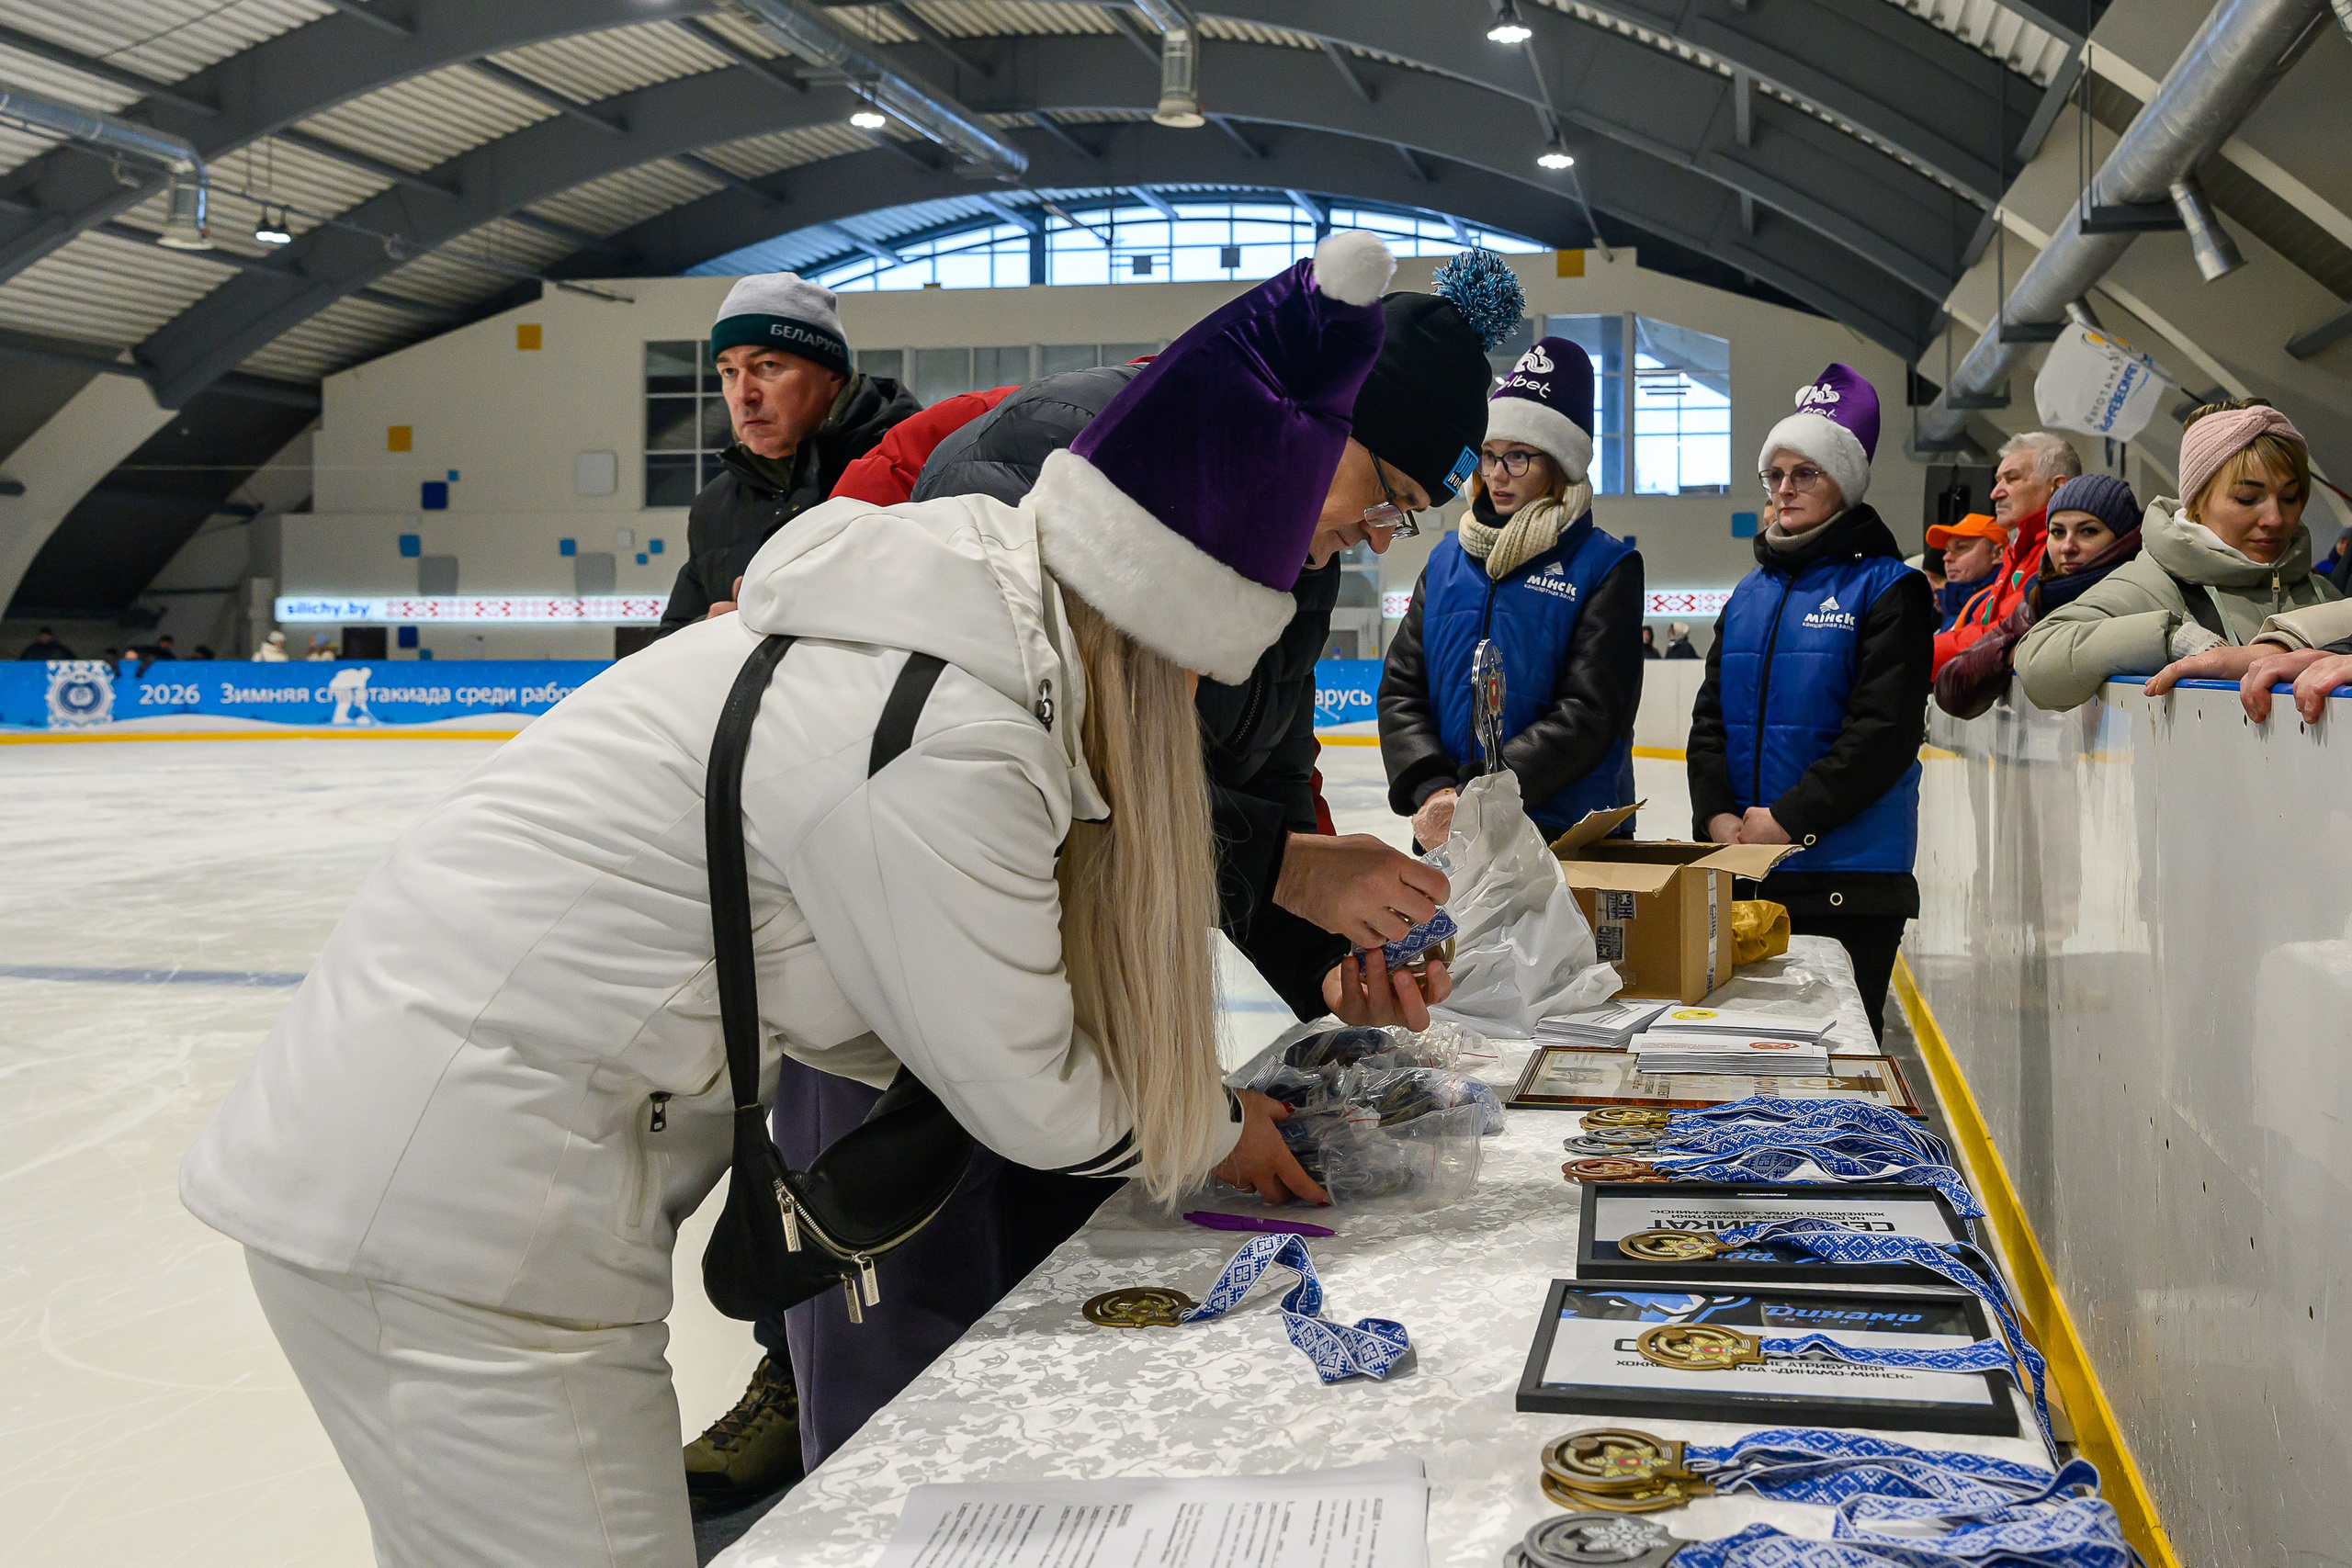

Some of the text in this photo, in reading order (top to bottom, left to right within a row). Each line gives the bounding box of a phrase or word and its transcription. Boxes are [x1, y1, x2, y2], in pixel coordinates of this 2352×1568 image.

[288, 602, 370, 618] silichy.by
[139, 682, 201, 705] 2026
[220, 682, 311, 705] Зимняя
[456, 685, 517, 707] среди
[1315, 688, 1374, 711] арусь
[1646, 1219, 1895, 1232] СЕИКАТ
